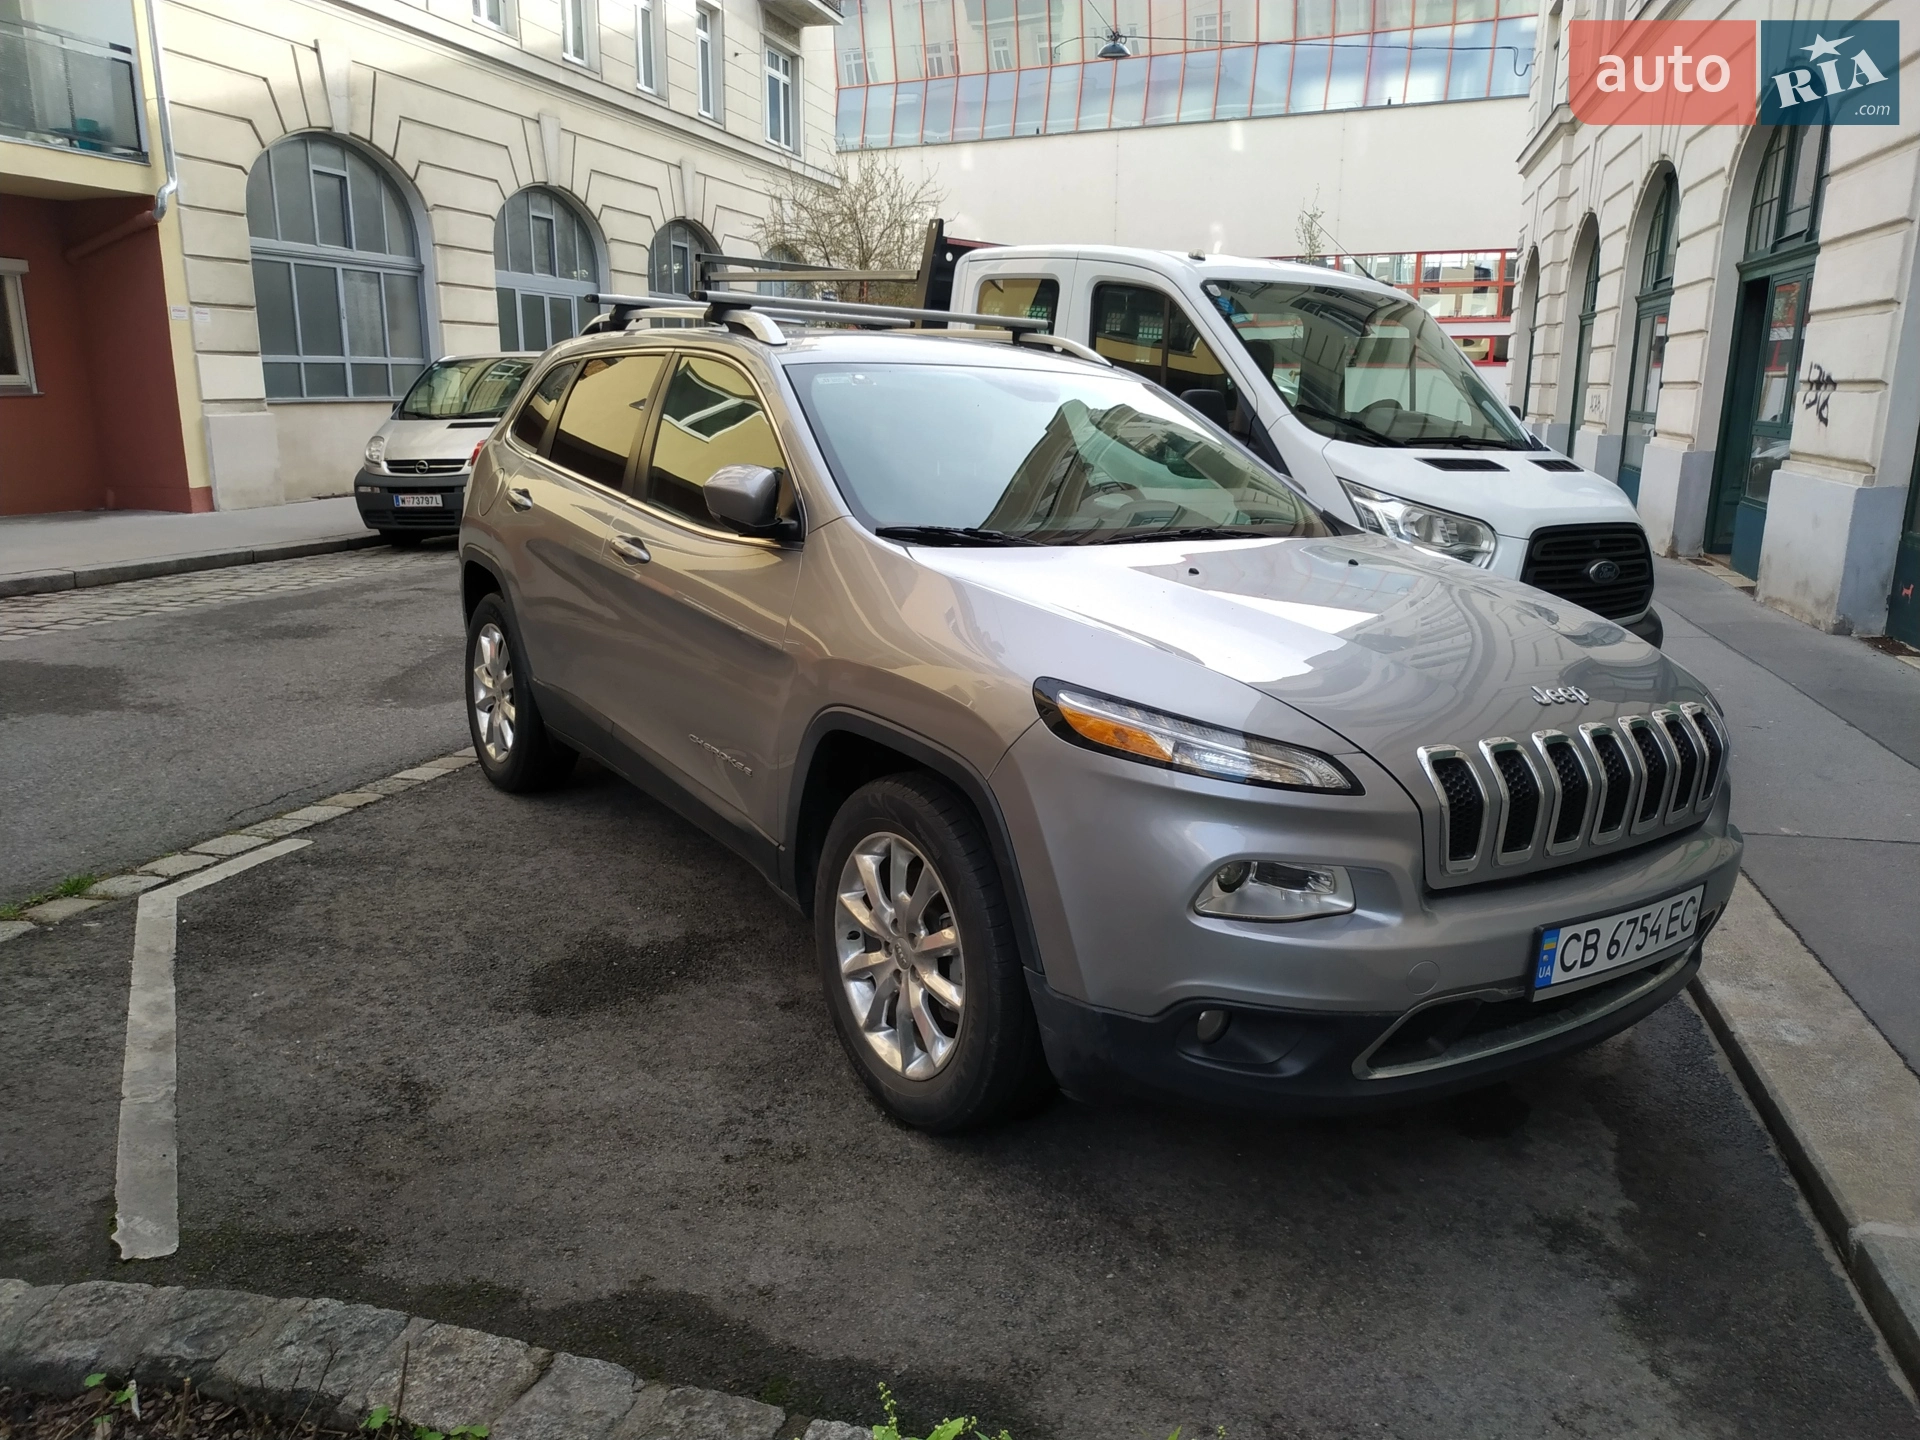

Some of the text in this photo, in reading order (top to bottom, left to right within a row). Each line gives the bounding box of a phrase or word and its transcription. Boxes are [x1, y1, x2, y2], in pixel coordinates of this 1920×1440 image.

[1531, 685, 1590, 705] Jeep
[688, 733, 752, 777] CHEROKEE
[1560, 896, 1697, 972] CB 6754 EC
[1538, 966, 1552, 979] UA
